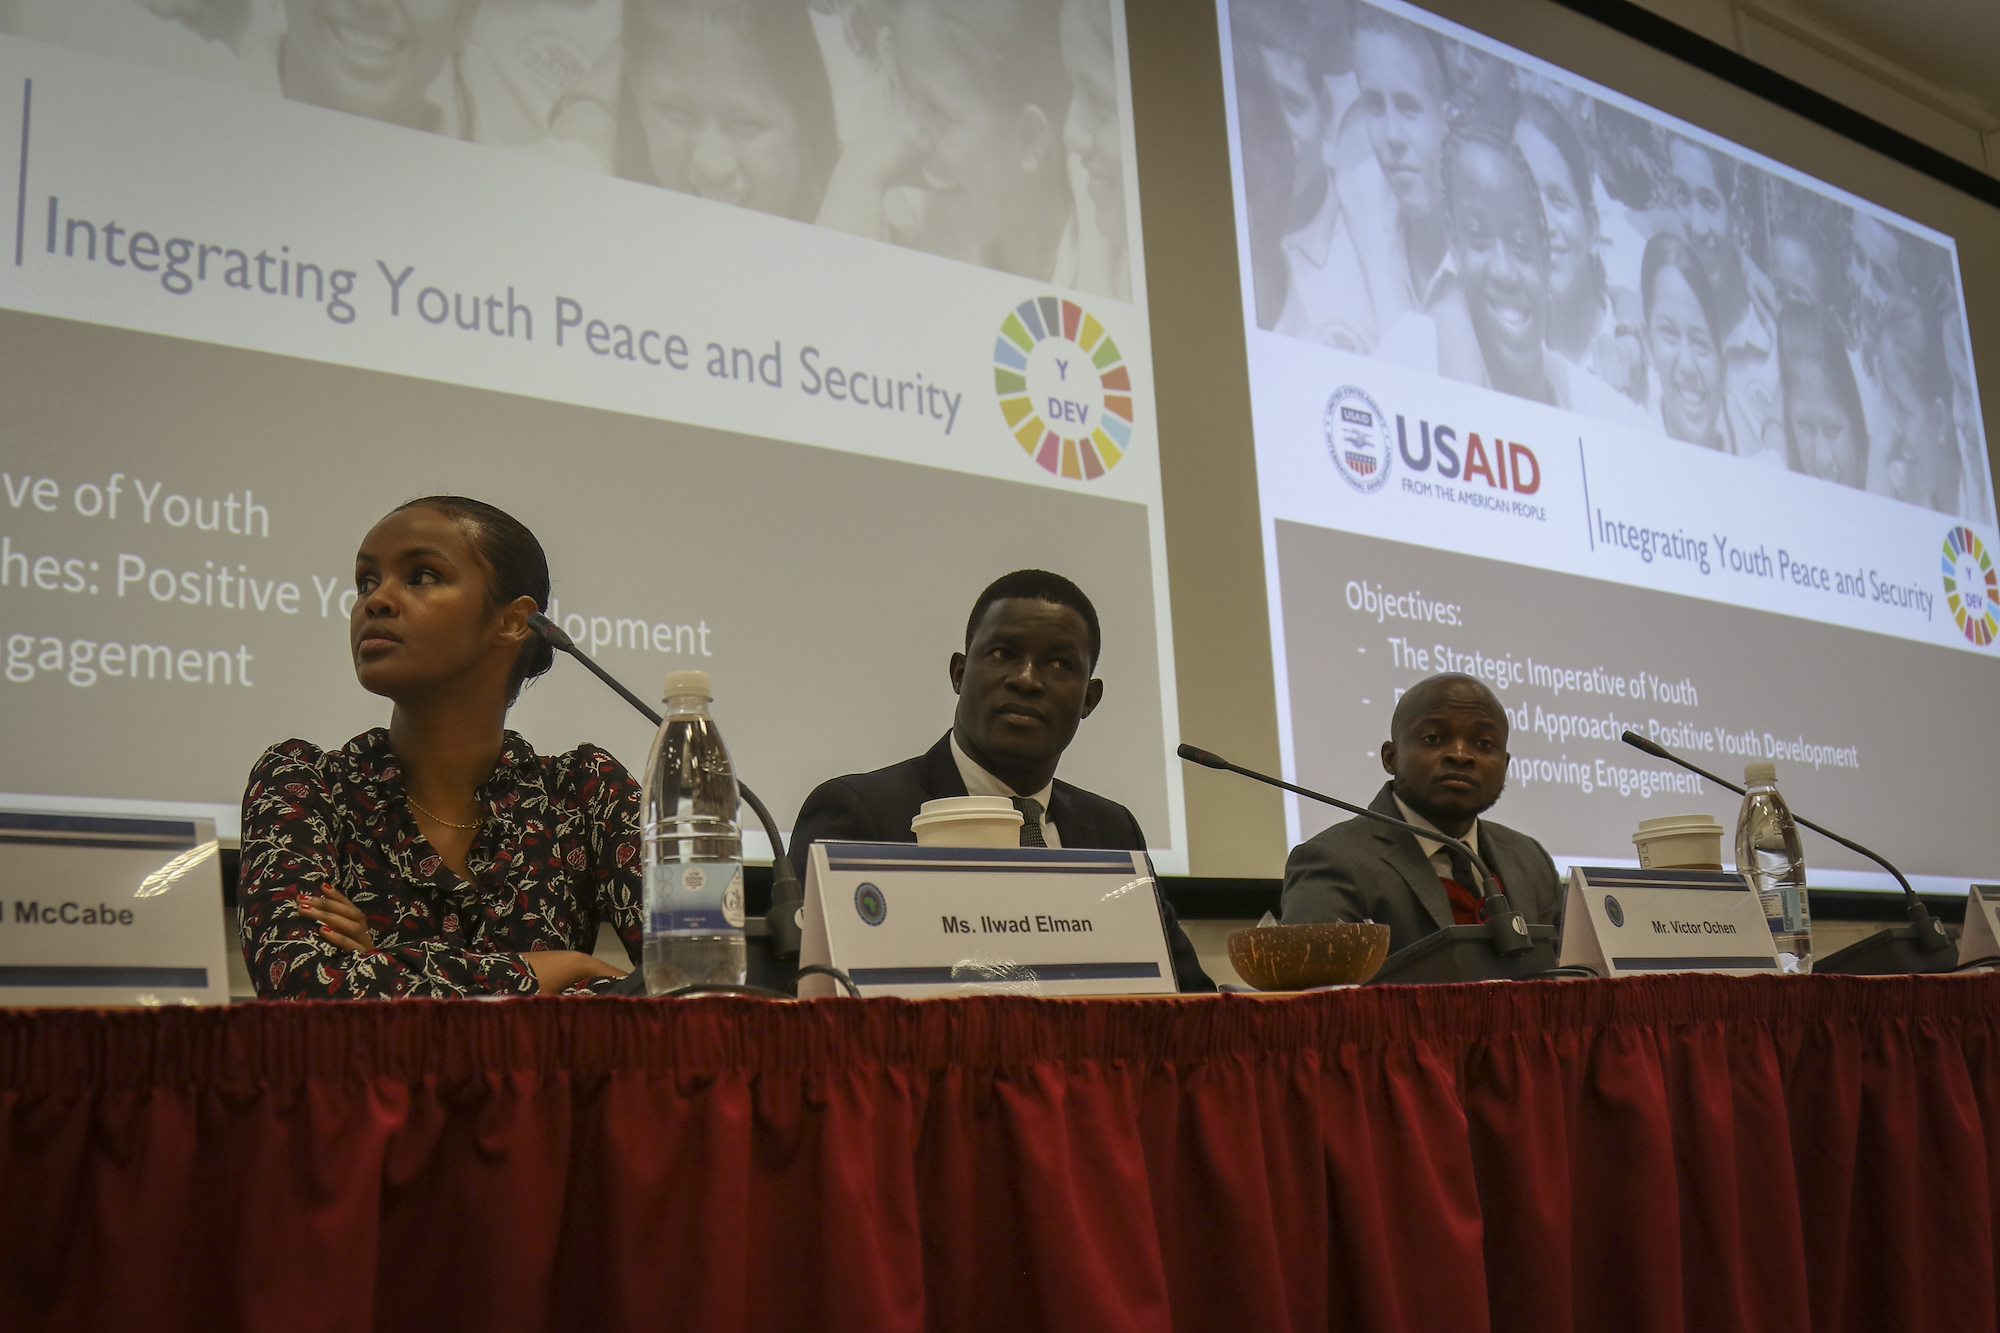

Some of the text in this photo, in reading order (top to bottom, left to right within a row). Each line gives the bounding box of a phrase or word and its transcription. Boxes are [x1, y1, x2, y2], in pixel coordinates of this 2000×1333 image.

[45, 195, 963, 436] Integrating Youth Peace and Security
[1055, 358, 1069, 381] Y
[1048, 397, 1090, 426] DEV
[1344, 409, 1370, 423] USAID
[1396, 414, 1541, 496] USAID
[74, 472, 125, 520] of
[134, 479, 269, 538] Youth
[1402, 478, 1547, 522] FROM THE AMERICAN PEOPLE
[117, 553, 300, 615] Positive
[1597, 508, 1934, 622] Integrating Youth Peace and Security
[1966, 567, 1972, 581] Y
[1345, 580, 1463, 626] Objectives:
[1965, 592, 1982, 609] DEV
[1388, 637, 1698, 708] The Strategic Imperative of Youth
[1649, 719, 1713, 752] Positive
[1715, 728, 1762, 757] Youth
[1763, 733, 1860, 770] Development
[1595, 759, 1704, 798] Engagement
[15, 902, 134, 925] McCabe
[941, 915, 1093, 934] Ms. Ilwad Elman
[1652, 919, 1737, 935] Mr. Victor Ochen
